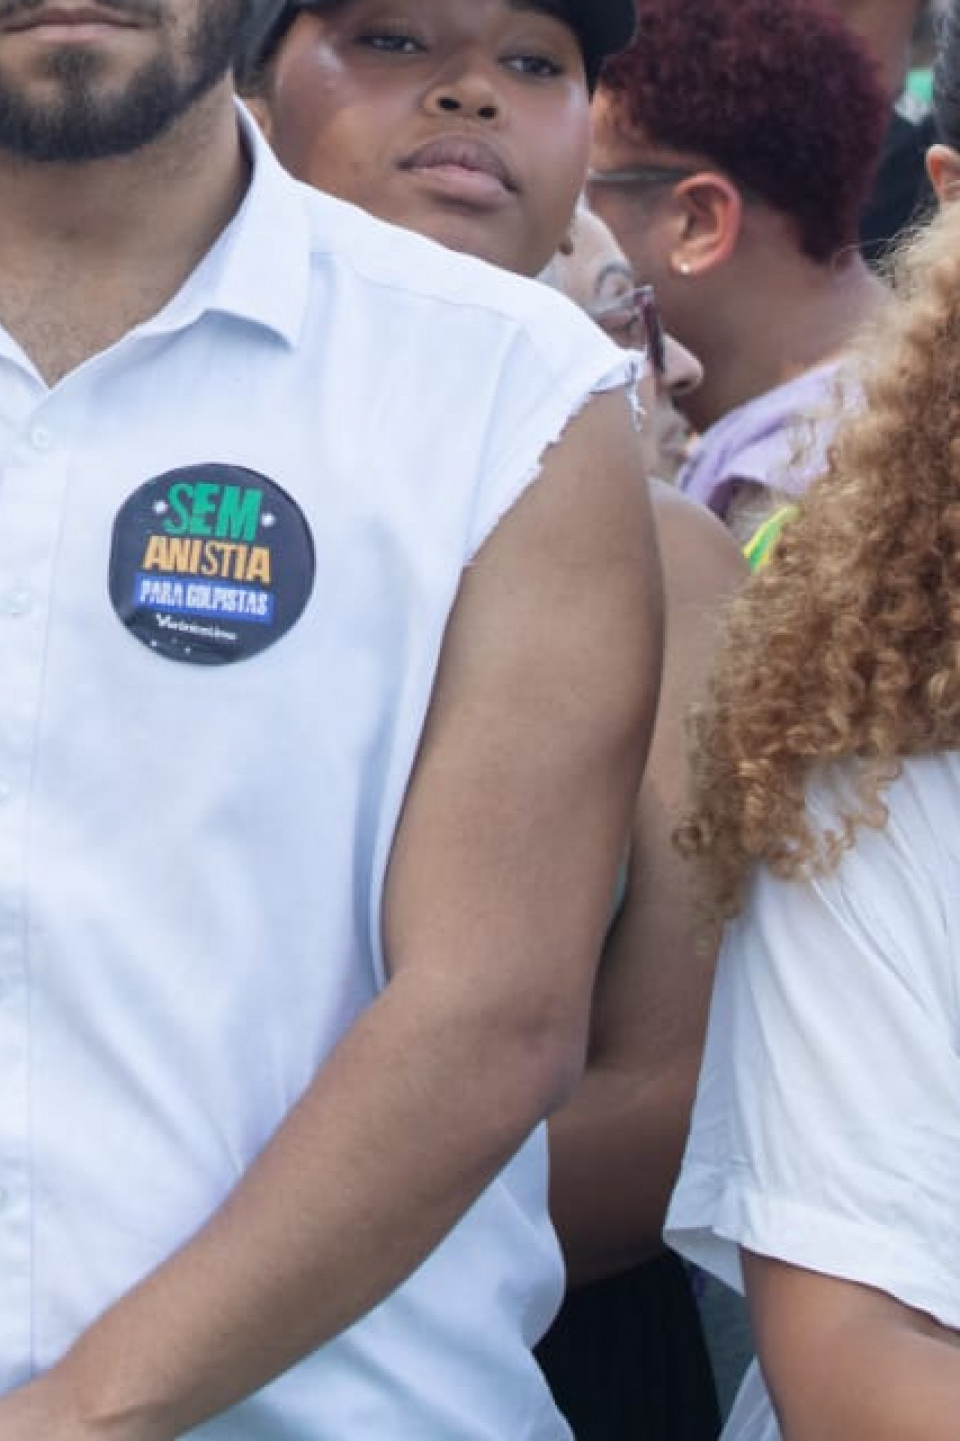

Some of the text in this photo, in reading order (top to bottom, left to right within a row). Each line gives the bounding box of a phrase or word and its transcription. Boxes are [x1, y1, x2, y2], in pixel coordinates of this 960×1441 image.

[162, 482, 263, 540] SEM
[143, 535, 270, 584] ANISTIA
[140, 579, 183, 606] PARA
